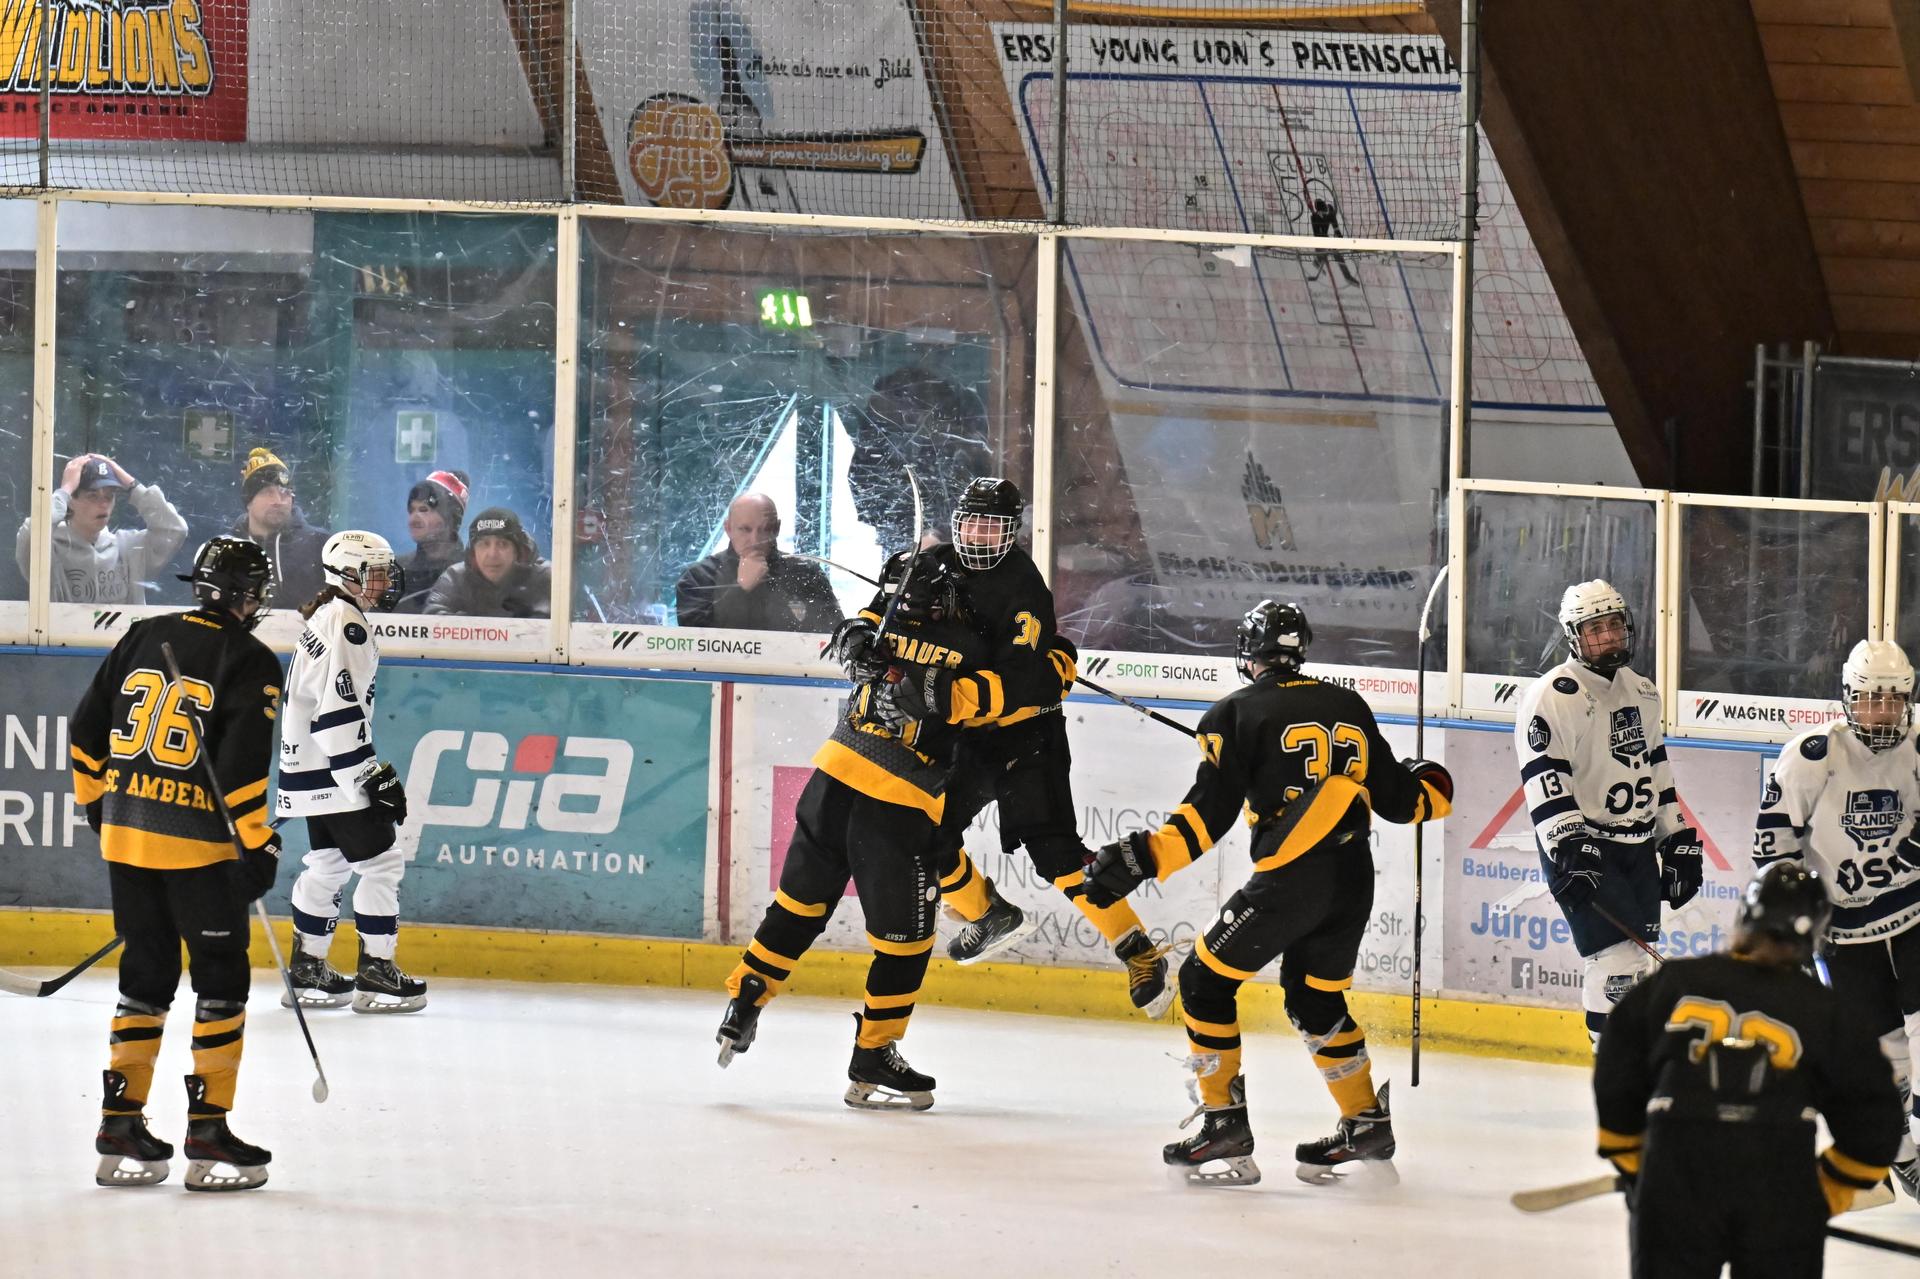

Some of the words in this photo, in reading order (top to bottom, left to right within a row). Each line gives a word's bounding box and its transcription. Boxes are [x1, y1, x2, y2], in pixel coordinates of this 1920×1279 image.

[1003, 34, 1069, 62] ERS
[1091, 38, 1179, 65] YOUNG
[1292, 41, 1459, 74] PATENSCHA
[745, 56, 789, 79] Mehr
[792, 58, 813, 77] als
[815, 64, 843, 78] nur
[845, 64, 872, 78] ein
[874, 57, 914, 88] Bild
[1273, 154, 1327, 175] CLUB
[371, 625, 428, 639] AGNER
[433, 627, 508, 641] SPEDITION
[646, 637, 695, 652] SPORT
[697, 639, 762, 655] SIGNAGE
[885, 631, 964, 670] ENAUER
[1116, 663, 1159, 678] SPORT
[1162, 665, 1218, 682] SIGNAGE
[1310, 676, 1356, 691] NER
[1358, 679, 1417, 695] SPEDITION
[109, 667, 214, 770] 36
[1723, 704, 1786, 723] WAGNER
[357, 721, 367, 743] 4
[1539, 771, 1564, 799] 13
[1752, 831, 1776, 856] 22
[436, 844, 645, 875] AUTOMATION
[1862, 908, 1920, 937] INDA
